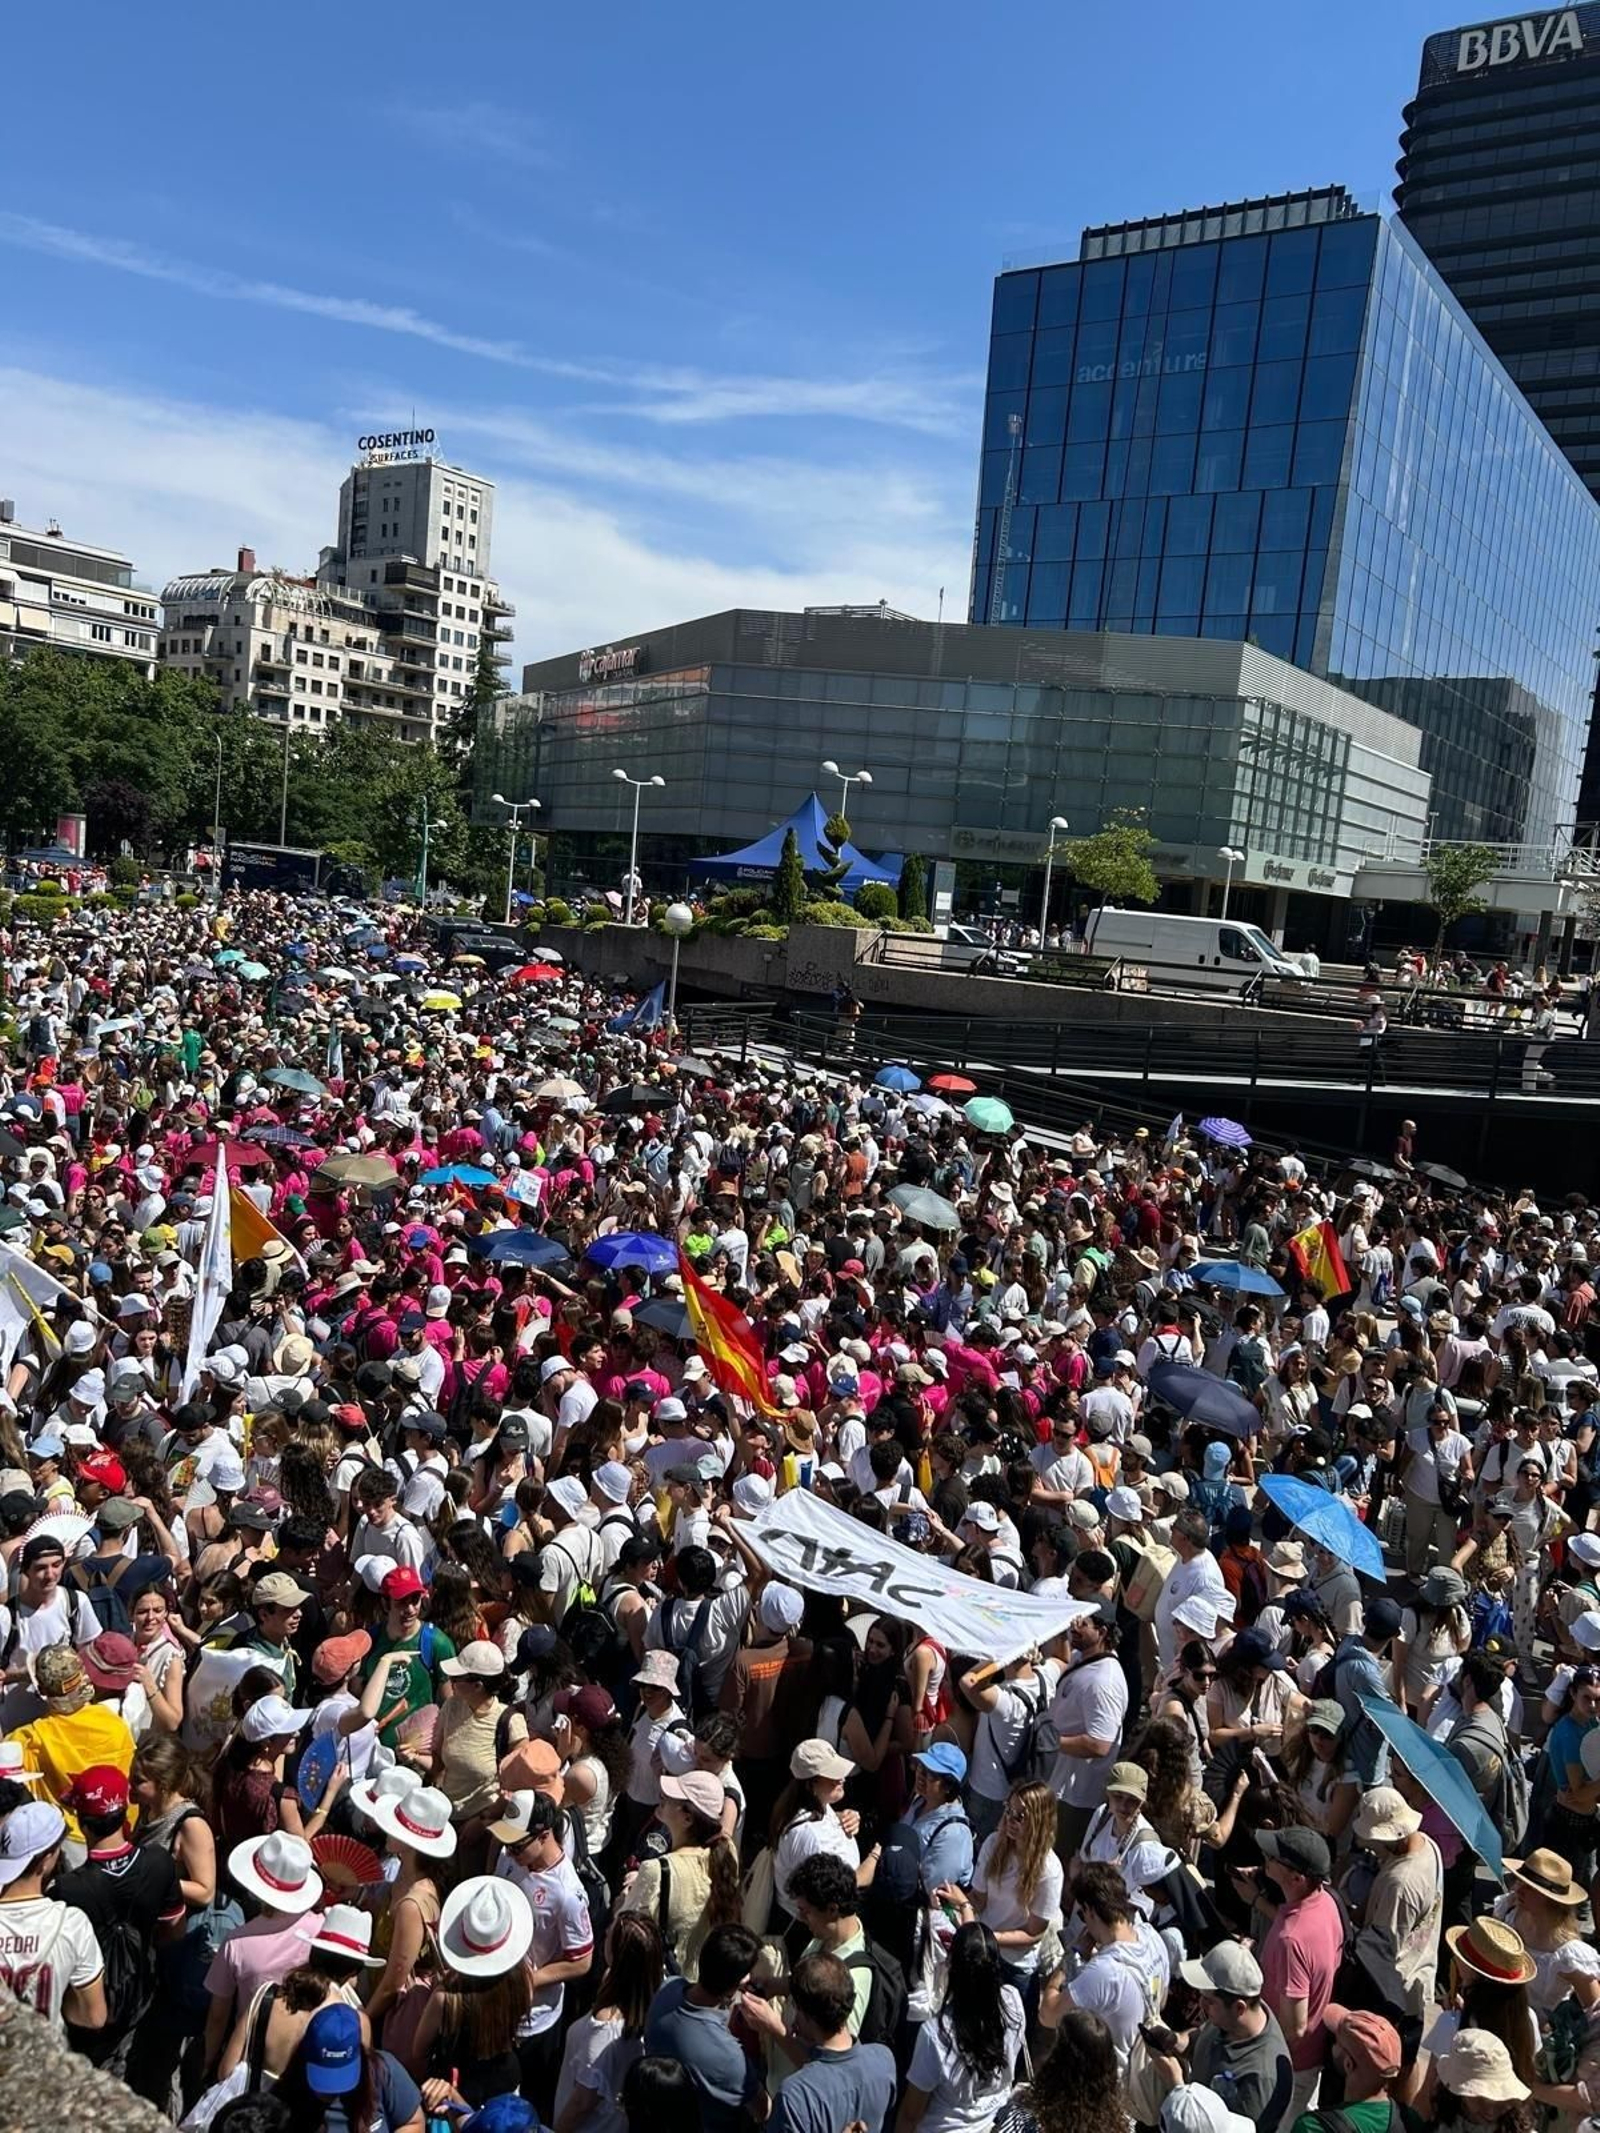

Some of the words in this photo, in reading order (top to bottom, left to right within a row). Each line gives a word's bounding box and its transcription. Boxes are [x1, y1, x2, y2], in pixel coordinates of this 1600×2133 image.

[1457, 10, 1584, 72] BBVA
[358, 429, 435, 450] COSENTINO
[371, 449, 419, 463] SURFACES
[593, 647, 641, 680] cajamar
